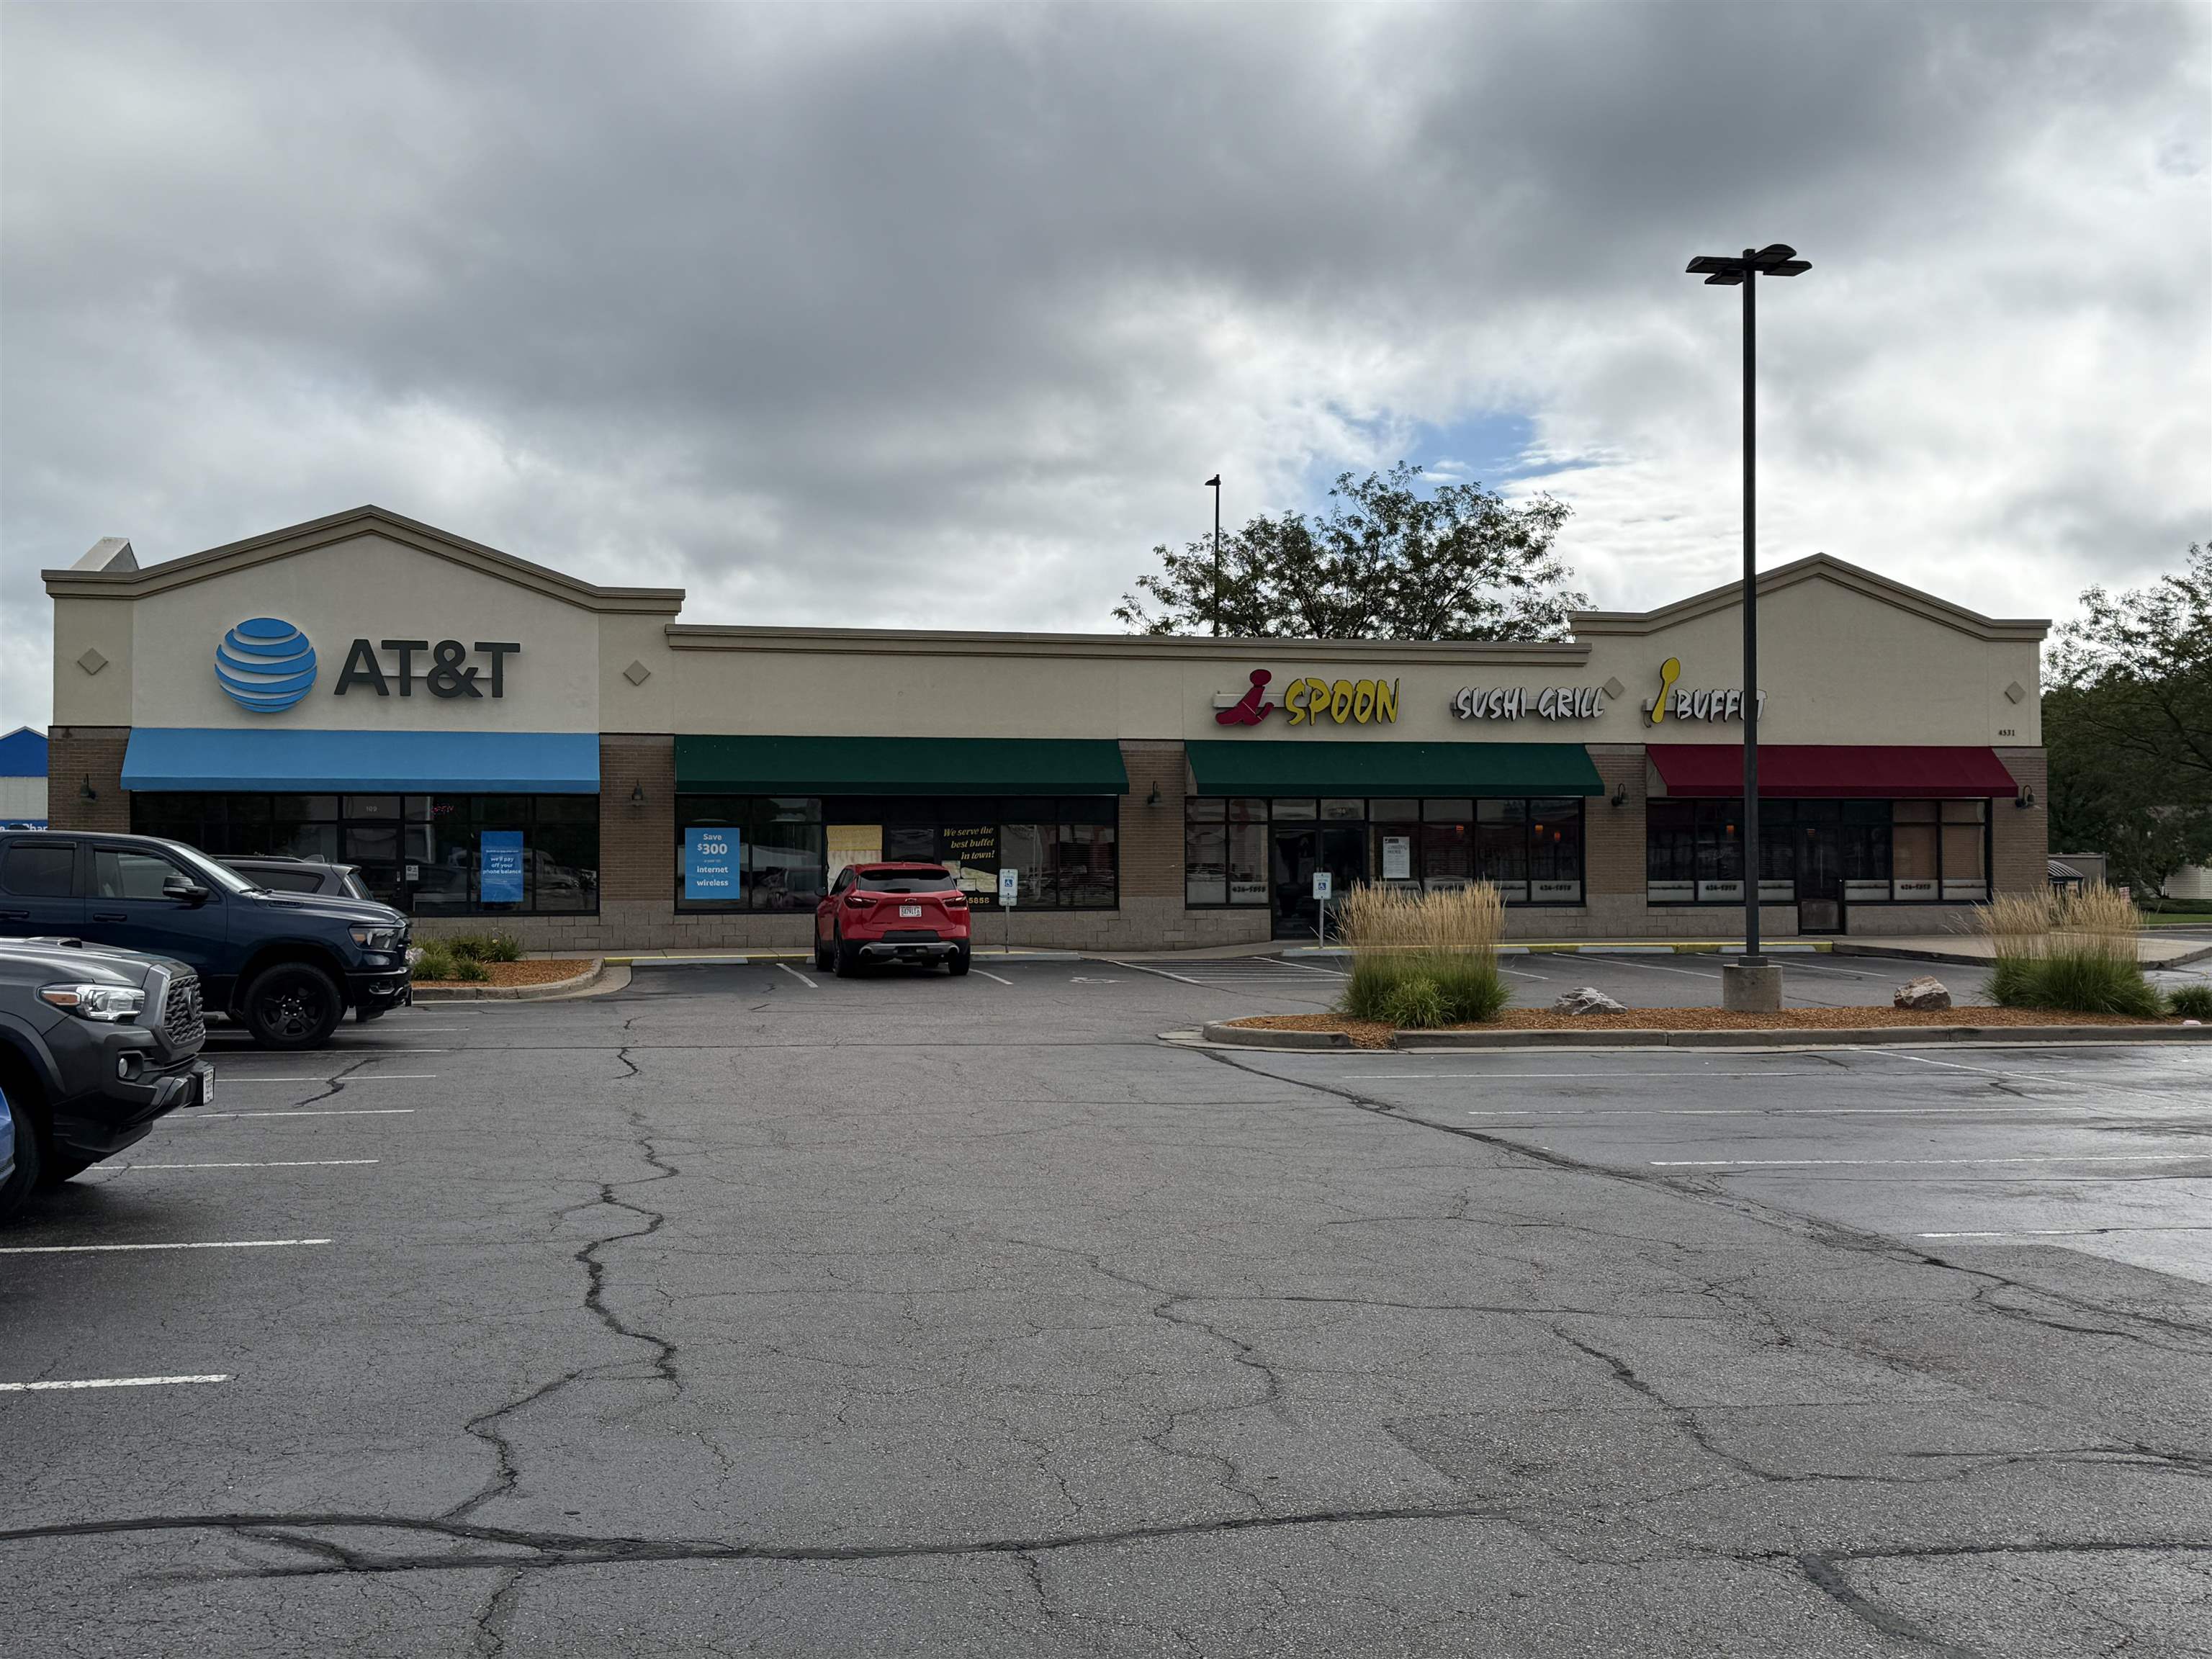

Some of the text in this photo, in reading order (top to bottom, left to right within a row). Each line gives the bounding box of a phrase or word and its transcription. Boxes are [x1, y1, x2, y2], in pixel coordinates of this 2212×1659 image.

[333, 638, 521, 698] AT&T
[1285, 677, 1400, 726] SPOON
[1456, 685, 1605, 721] SUSHI GRILL
[1675, 688, 1768, 722] BUFFT
[943, 828, 956, 837] We
[950, 838, 994, 848] best buffet
[697, 843, 728, 855] $300
[961, 850, 995, 860] in town!
